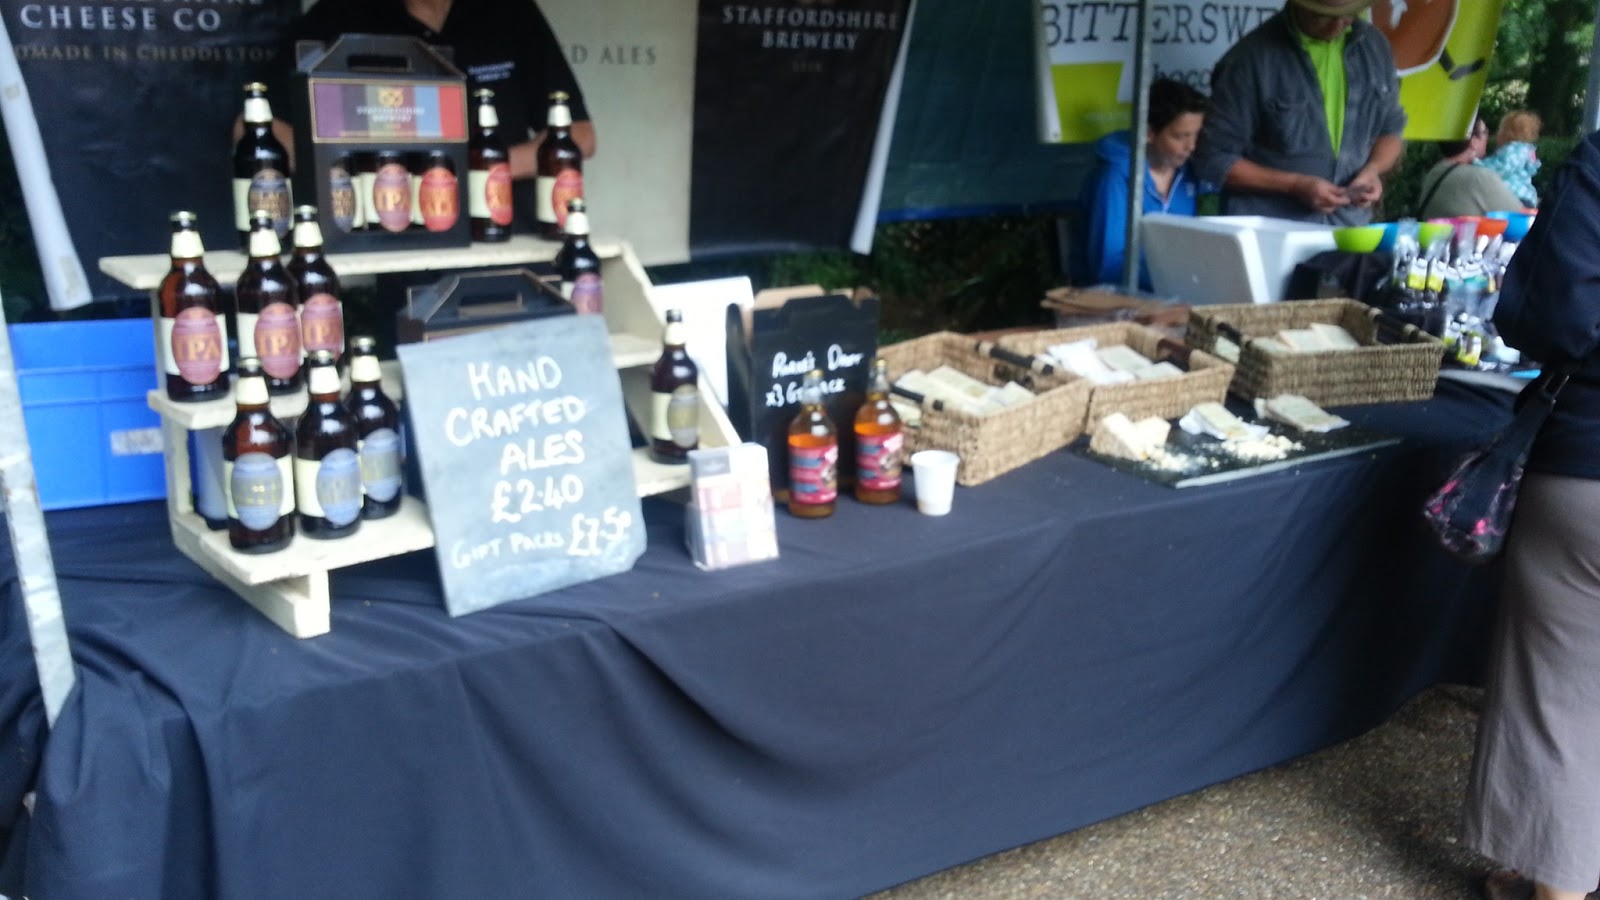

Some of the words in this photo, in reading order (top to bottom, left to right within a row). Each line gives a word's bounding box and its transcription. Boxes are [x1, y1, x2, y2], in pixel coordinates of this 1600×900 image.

[20, 4, 157, 31] CHEESE
[172, 8, 222, 32] CO
[722, 5, 898, 30] STAFFORDSHIRE
[761, 29, 859, 50] BREWERY
[103, 46, 128, 61] IN
[600, 46, 658, 65] ALES
[176, 336, 221, 362] IPA
[467, 355, 562, 401] HAND
[445, 395, 587, 447] CRAFTED
[500, 429, 586, 475] ALES
